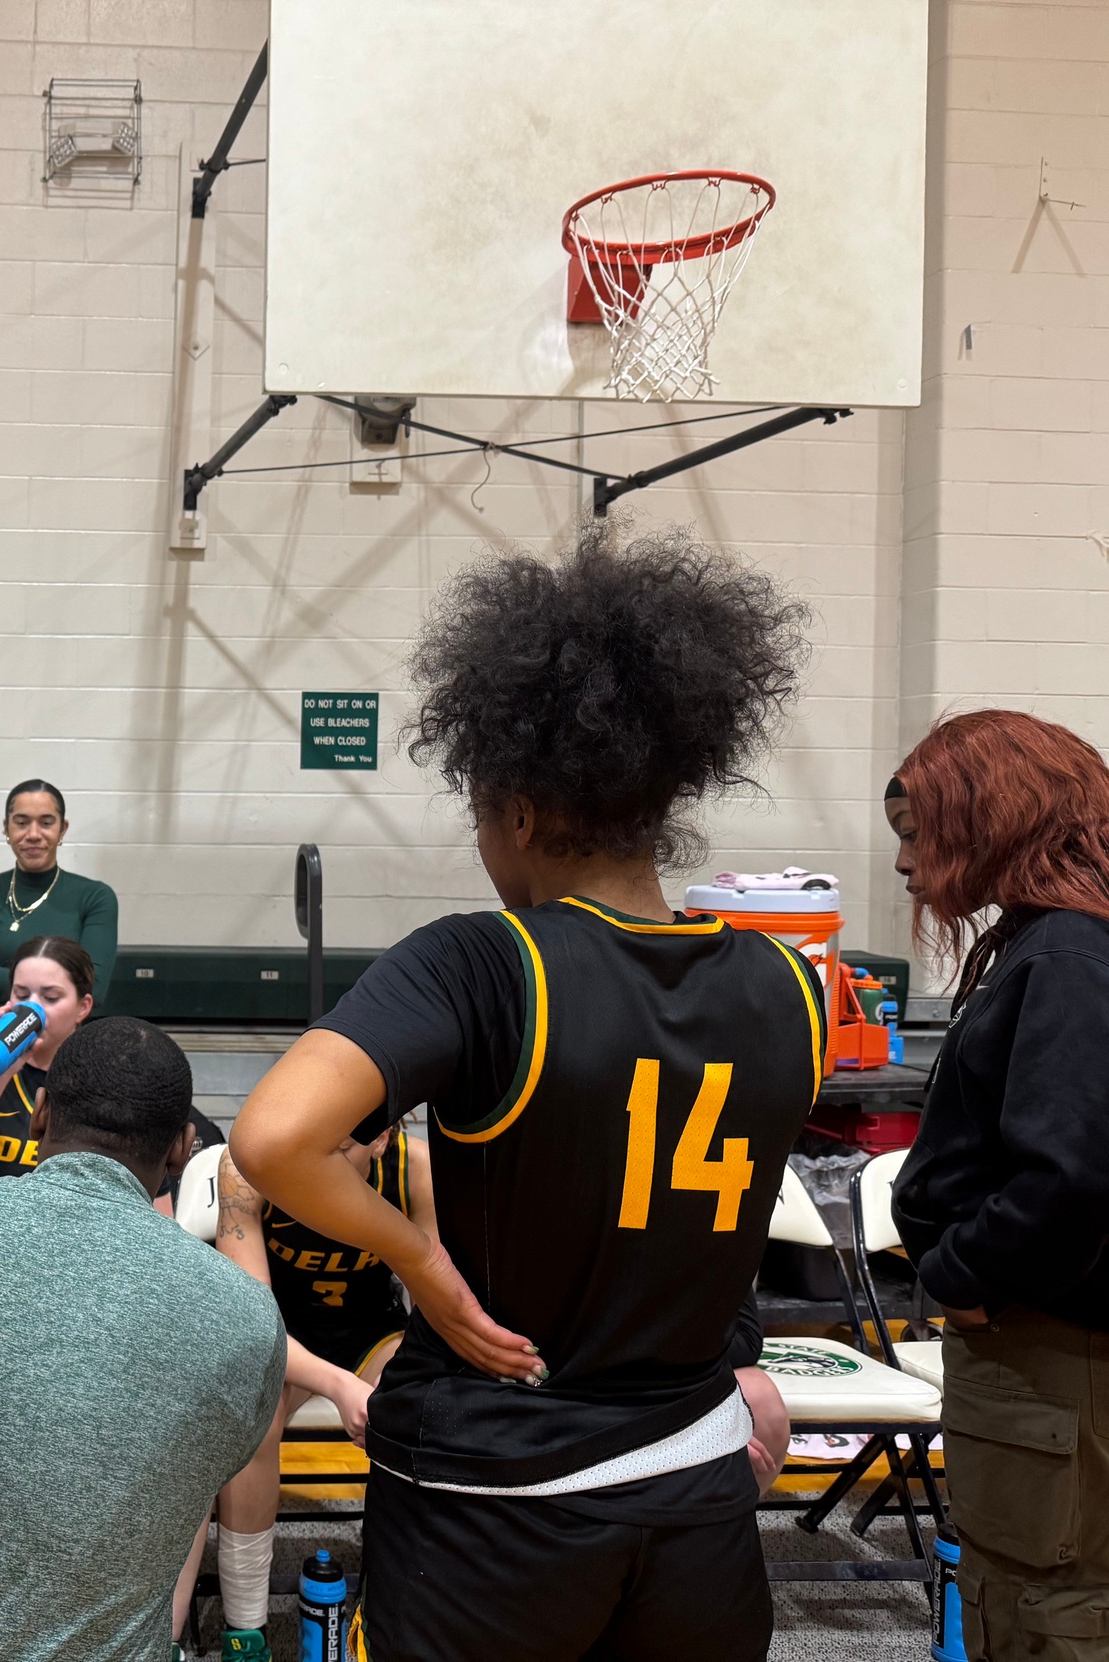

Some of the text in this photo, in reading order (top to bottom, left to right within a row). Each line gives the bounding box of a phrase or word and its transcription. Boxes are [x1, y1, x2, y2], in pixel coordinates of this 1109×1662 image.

[304, 699, 377, 709] DO NOT SIT ON OR
[310, 717, 370, 728] USE BLEACHERS
[313, 736, 366, 746] WHEN CLOSED
[334, 754, 372, 763] Thank You
[618, 1057, 755, 1232] 14
